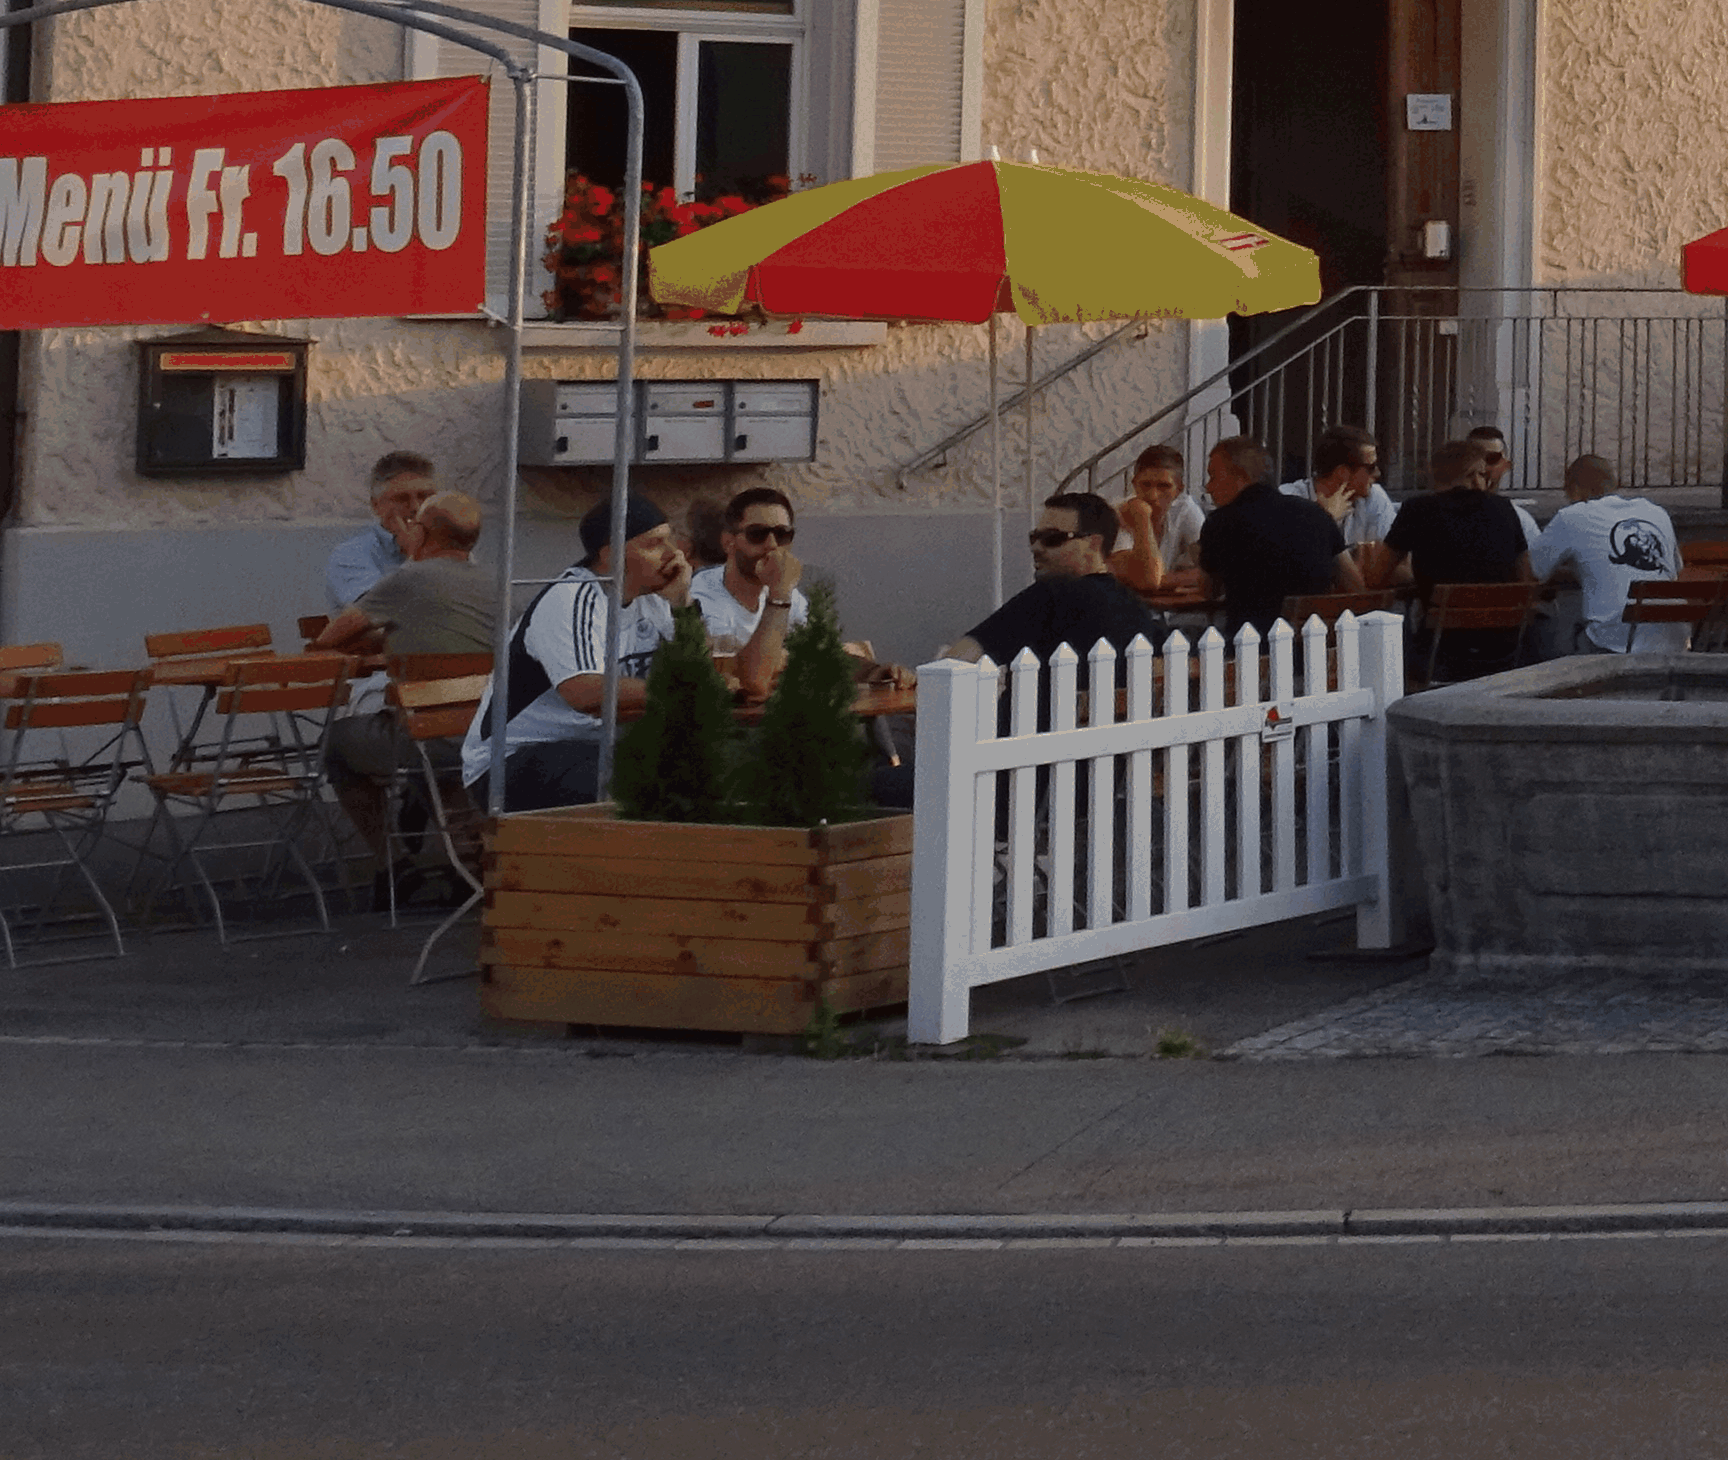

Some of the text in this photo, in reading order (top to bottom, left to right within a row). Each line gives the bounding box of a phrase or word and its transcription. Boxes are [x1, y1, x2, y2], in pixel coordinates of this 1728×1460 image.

[0, 130, 463, 267] Menü Fr. 16.50
